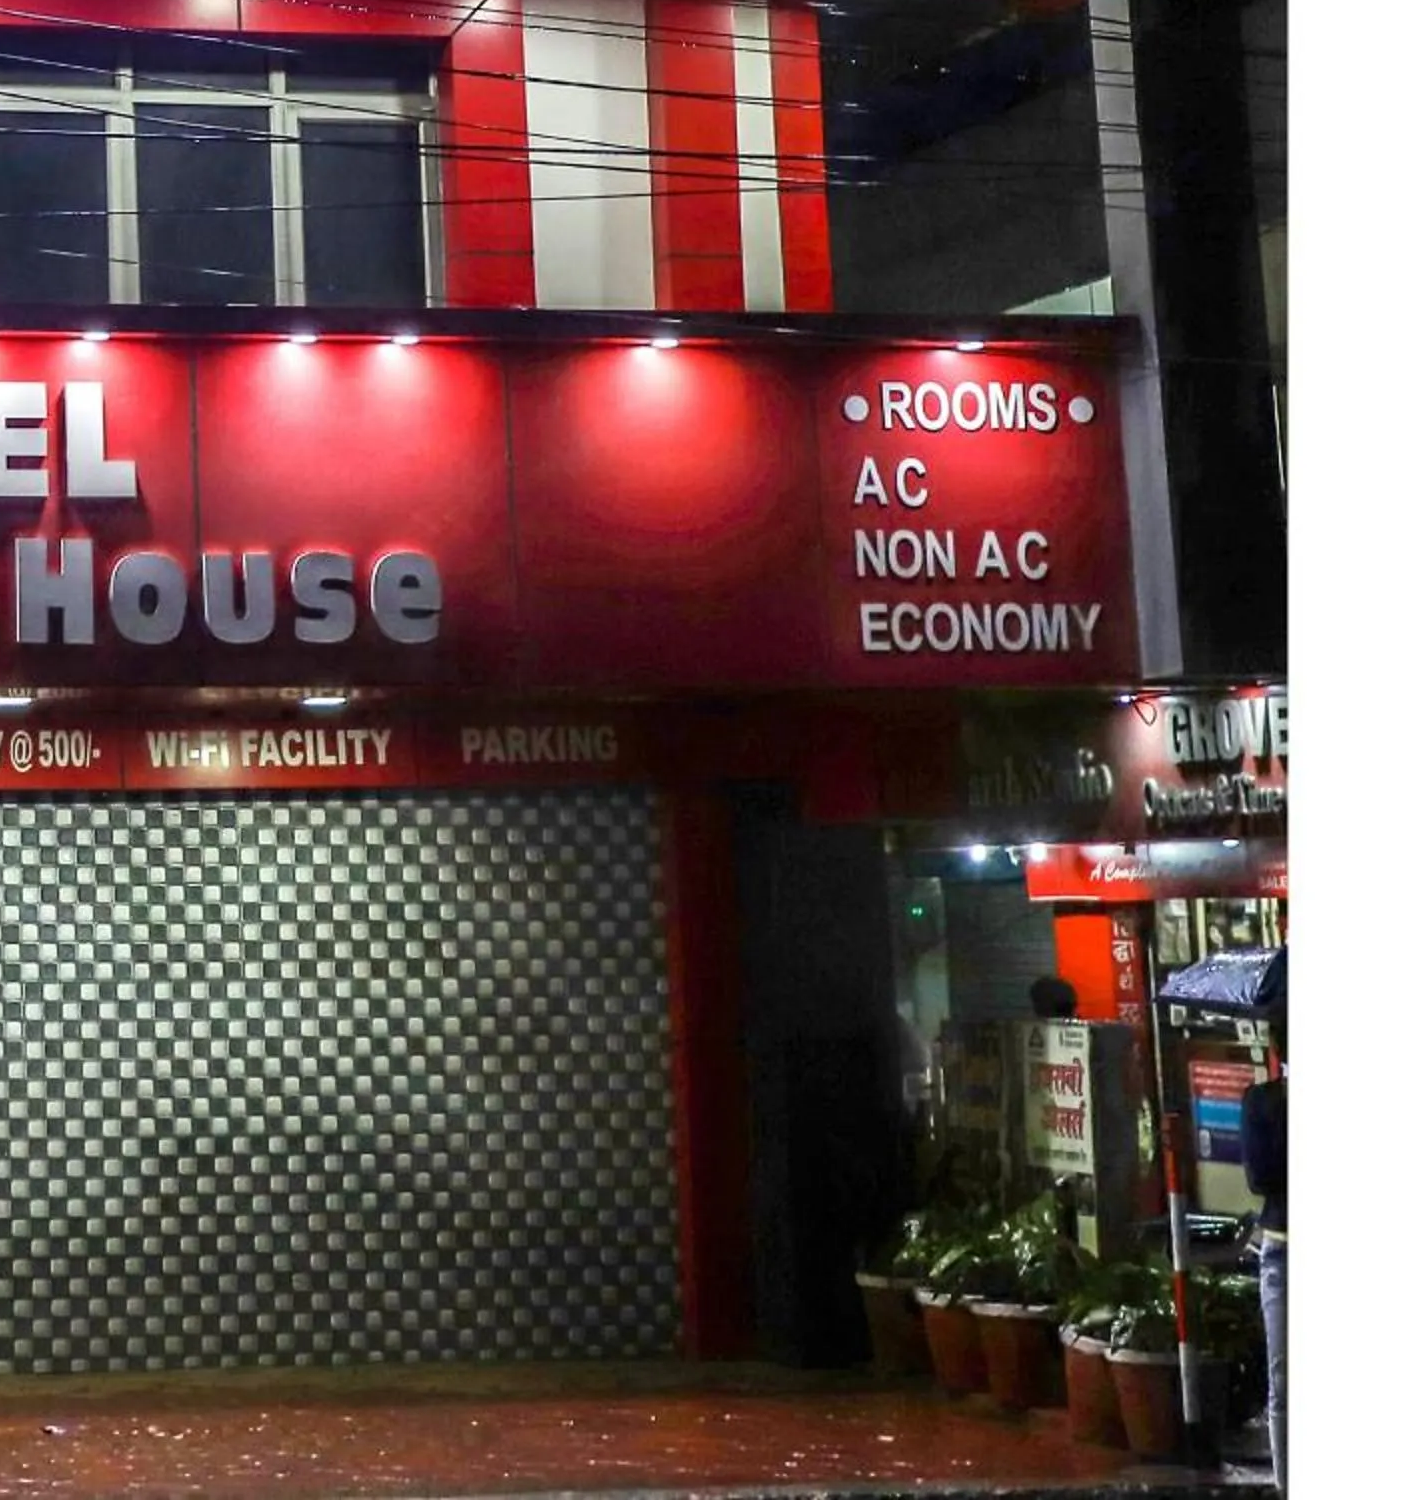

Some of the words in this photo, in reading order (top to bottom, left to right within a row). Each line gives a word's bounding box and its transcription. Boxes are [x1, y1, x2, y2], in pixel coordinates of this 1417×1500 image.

[881, 381, 1059, 431] ROOMS
[854, 529, 956, 579] NON
[14, 536, 444, 646] House
[860, 603, 1102, 651] ECONOMY
[10, 730, 33, 773] @
[39, 730, 101, 768] 500/-
[147, 730, 231, 769] Wi-Fi
[239, 728, 392, 767] FACILITY
[460, 724, 618, 765] PARKING
